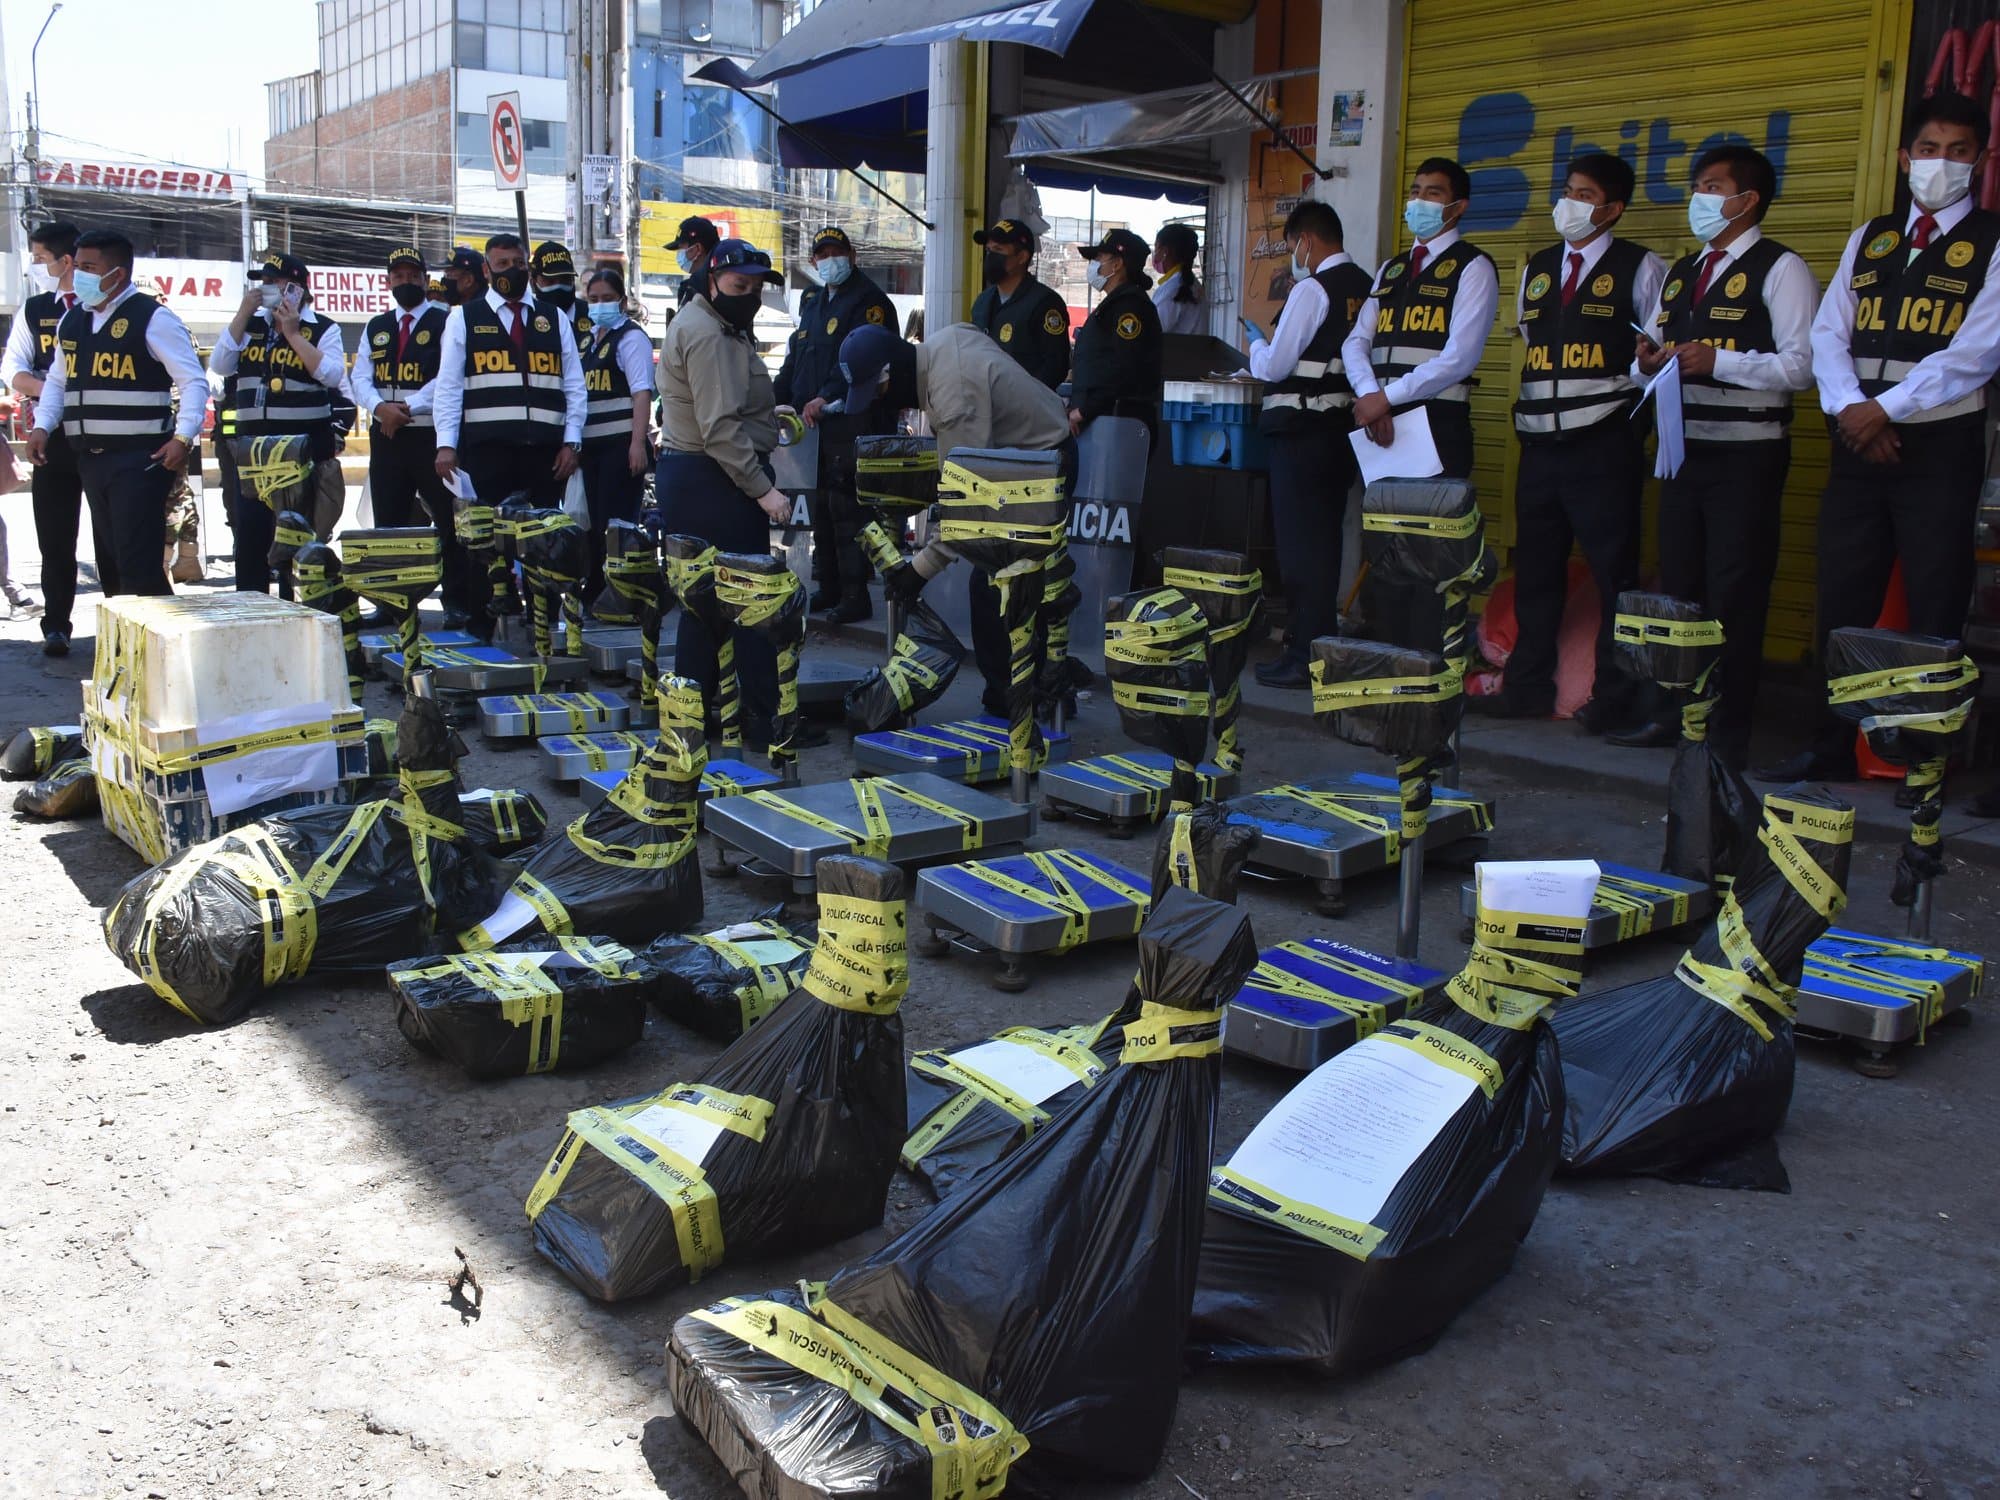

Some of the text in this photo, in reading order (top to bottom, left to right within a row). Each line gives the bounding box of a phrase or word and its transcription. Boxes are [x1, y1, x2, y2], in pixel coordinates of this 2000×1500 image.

[36, 160, 233, 194] CARNICERIA
[306, 271, 391, 292] CONCYS
[313, 293, 390, 313] CARNES
[474, 350, 516, 374] POL
[1801, 816, 1838, 832] POLICÍA
[1770, 834, 1824, 895] POLICÍA FISCAL
[850, 912, 886, 927] FISCAL
[875, 940, 908, 954] FISCAL
[835, 953, 873, 976] FISCAL
[1425, 1035, 1497, 1091] POLICÍA FISCAL
[655, 1160, 684, 1183] POLICÍA
[679, 1189, 697, 1223] POLICÍA
[1284, 1210, 1365, 1246] POLICÍA FISCAL
[788, 1329, 831, 1359] FISCAL
